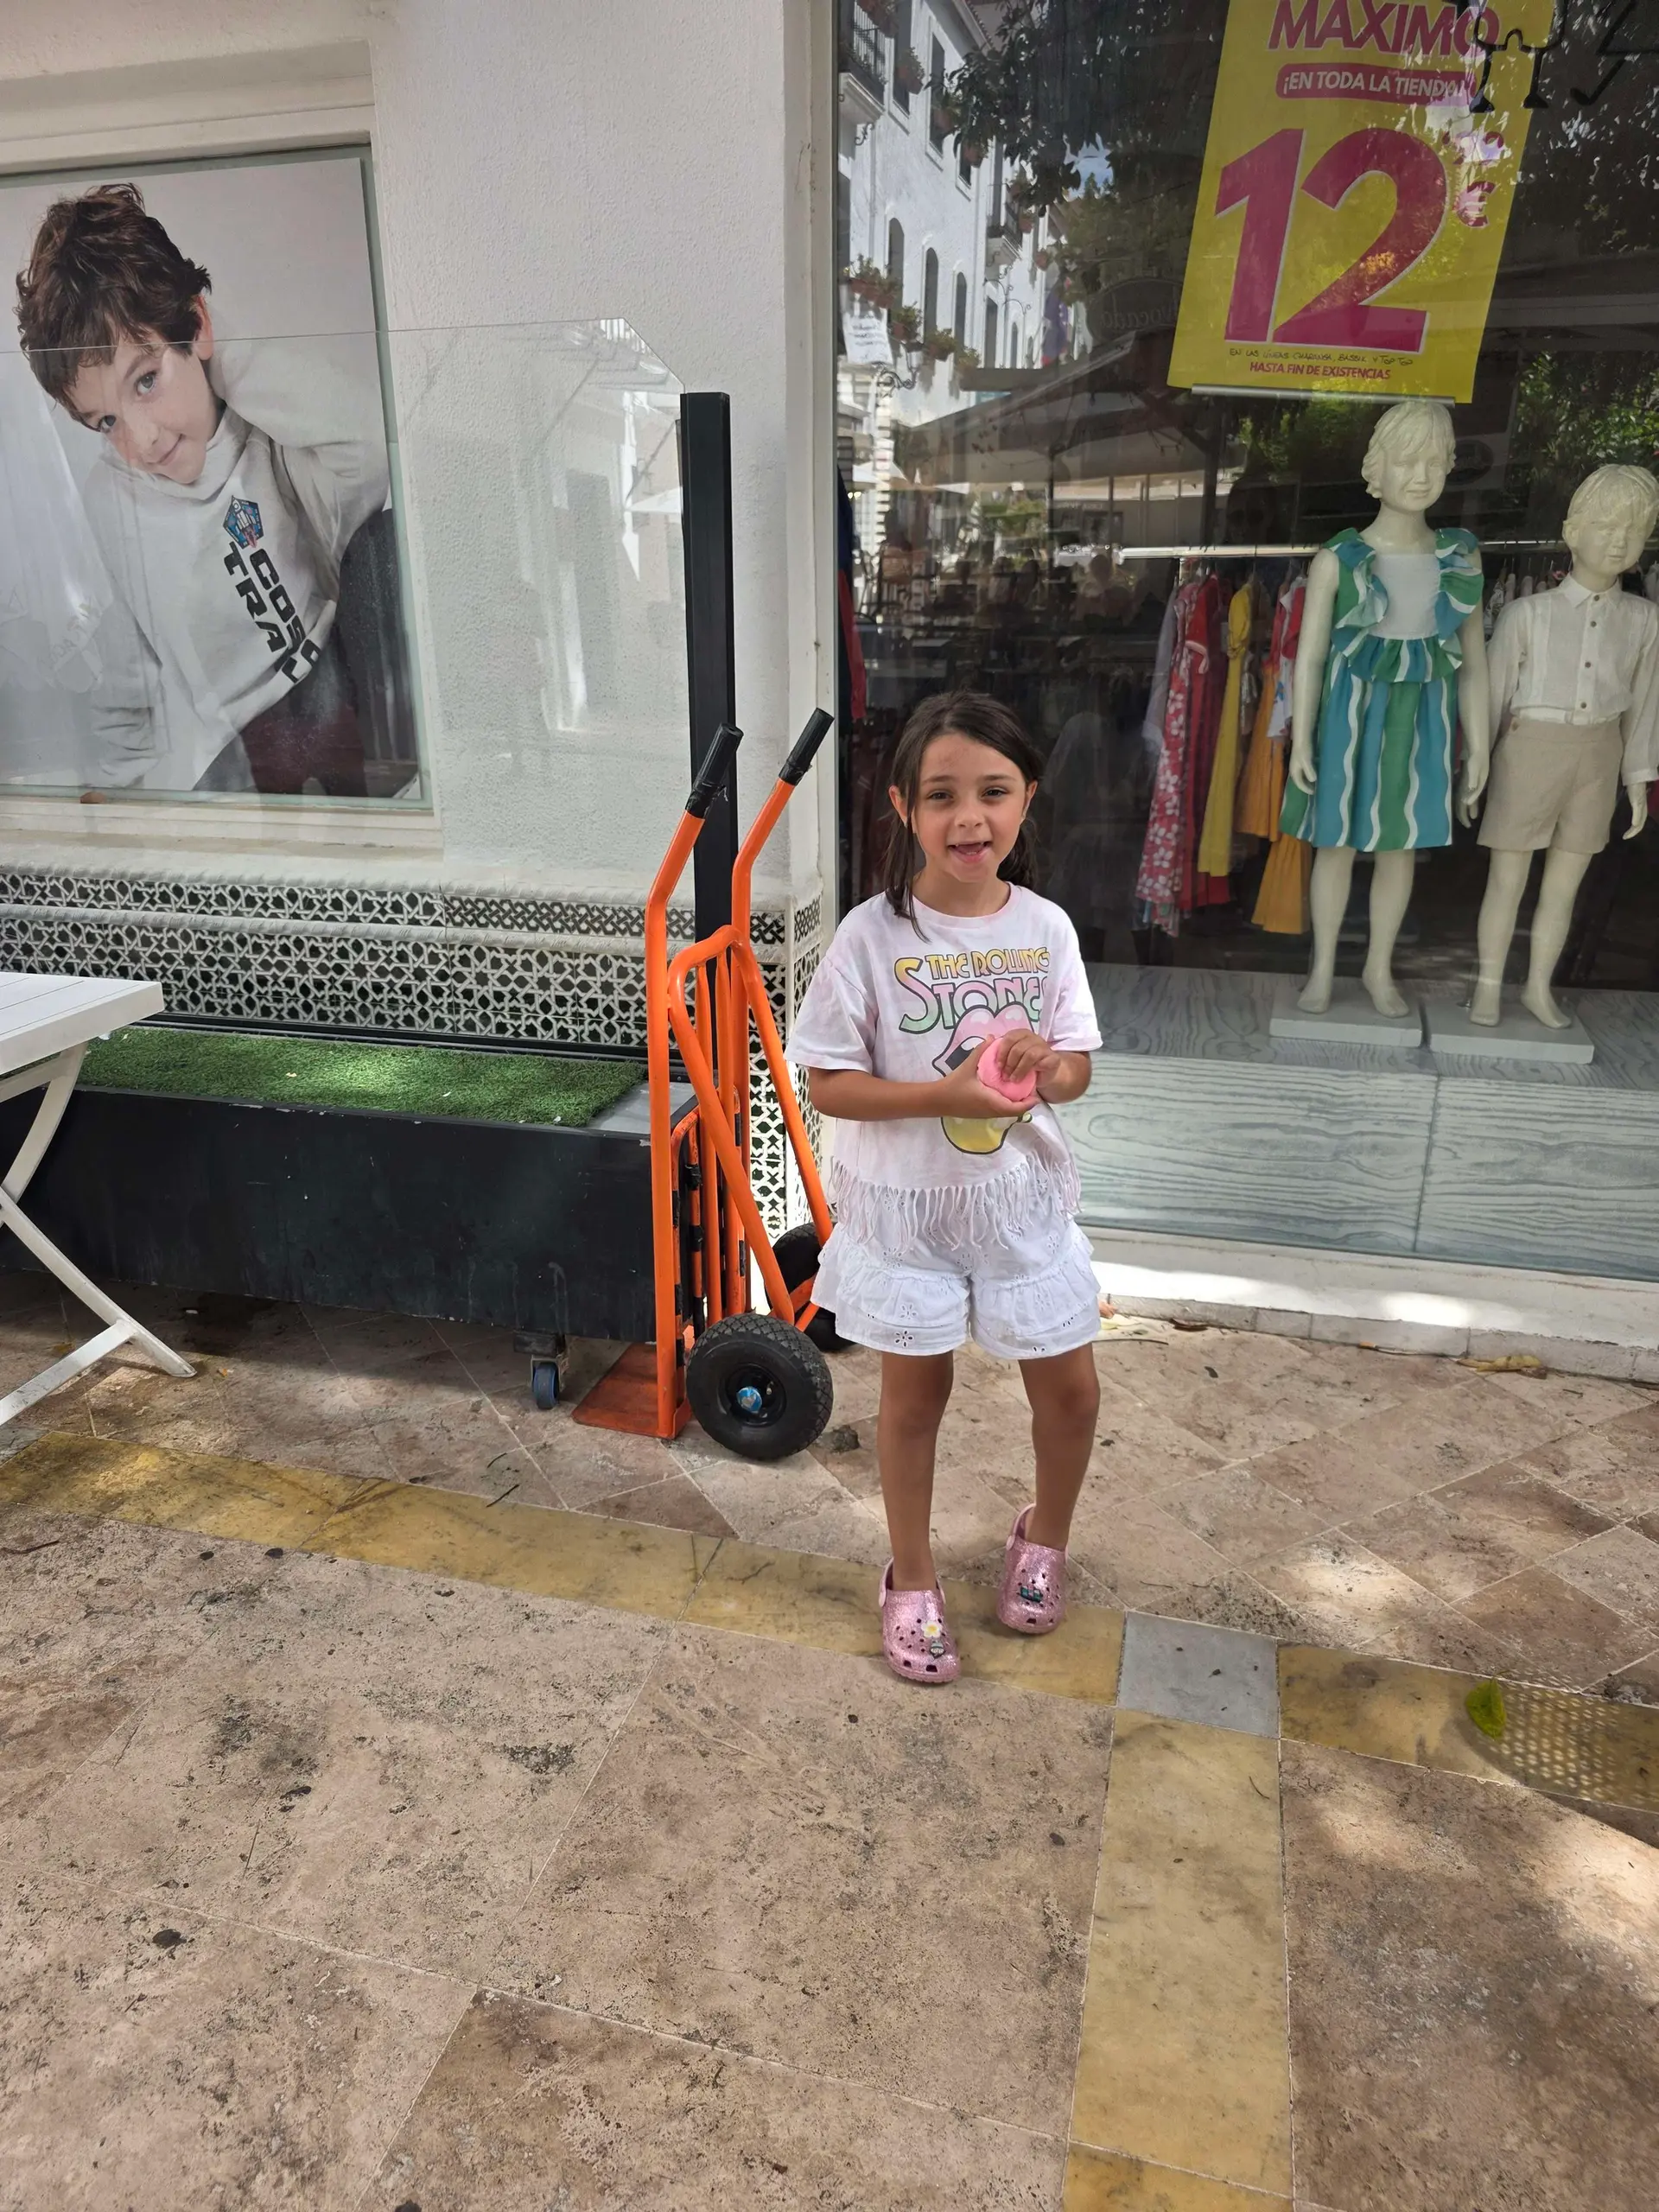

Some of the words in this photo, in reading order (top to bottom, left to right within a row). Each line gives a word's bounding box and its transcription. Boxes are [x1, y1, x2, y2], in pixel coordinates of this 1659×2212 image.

[1282, 72, 1313, 94] ¡EN
[1317, 72, 1365, 90] TODA
[1369, 74, 1391, 92] LA
[1214, 127, 1448, 353] 12
[1245, 349, 1260, 358] LAS
[1249, 361, 1285, 374] HASTA
[1287, 364, 1304, 375] FIN
[1306, 365, 1321, 376] DE
[1322, 365, 1391, 380] EXISTENCIAS
[925, 953, 970, 980] THE
[971, 947, 1051, 976] ROLLING
